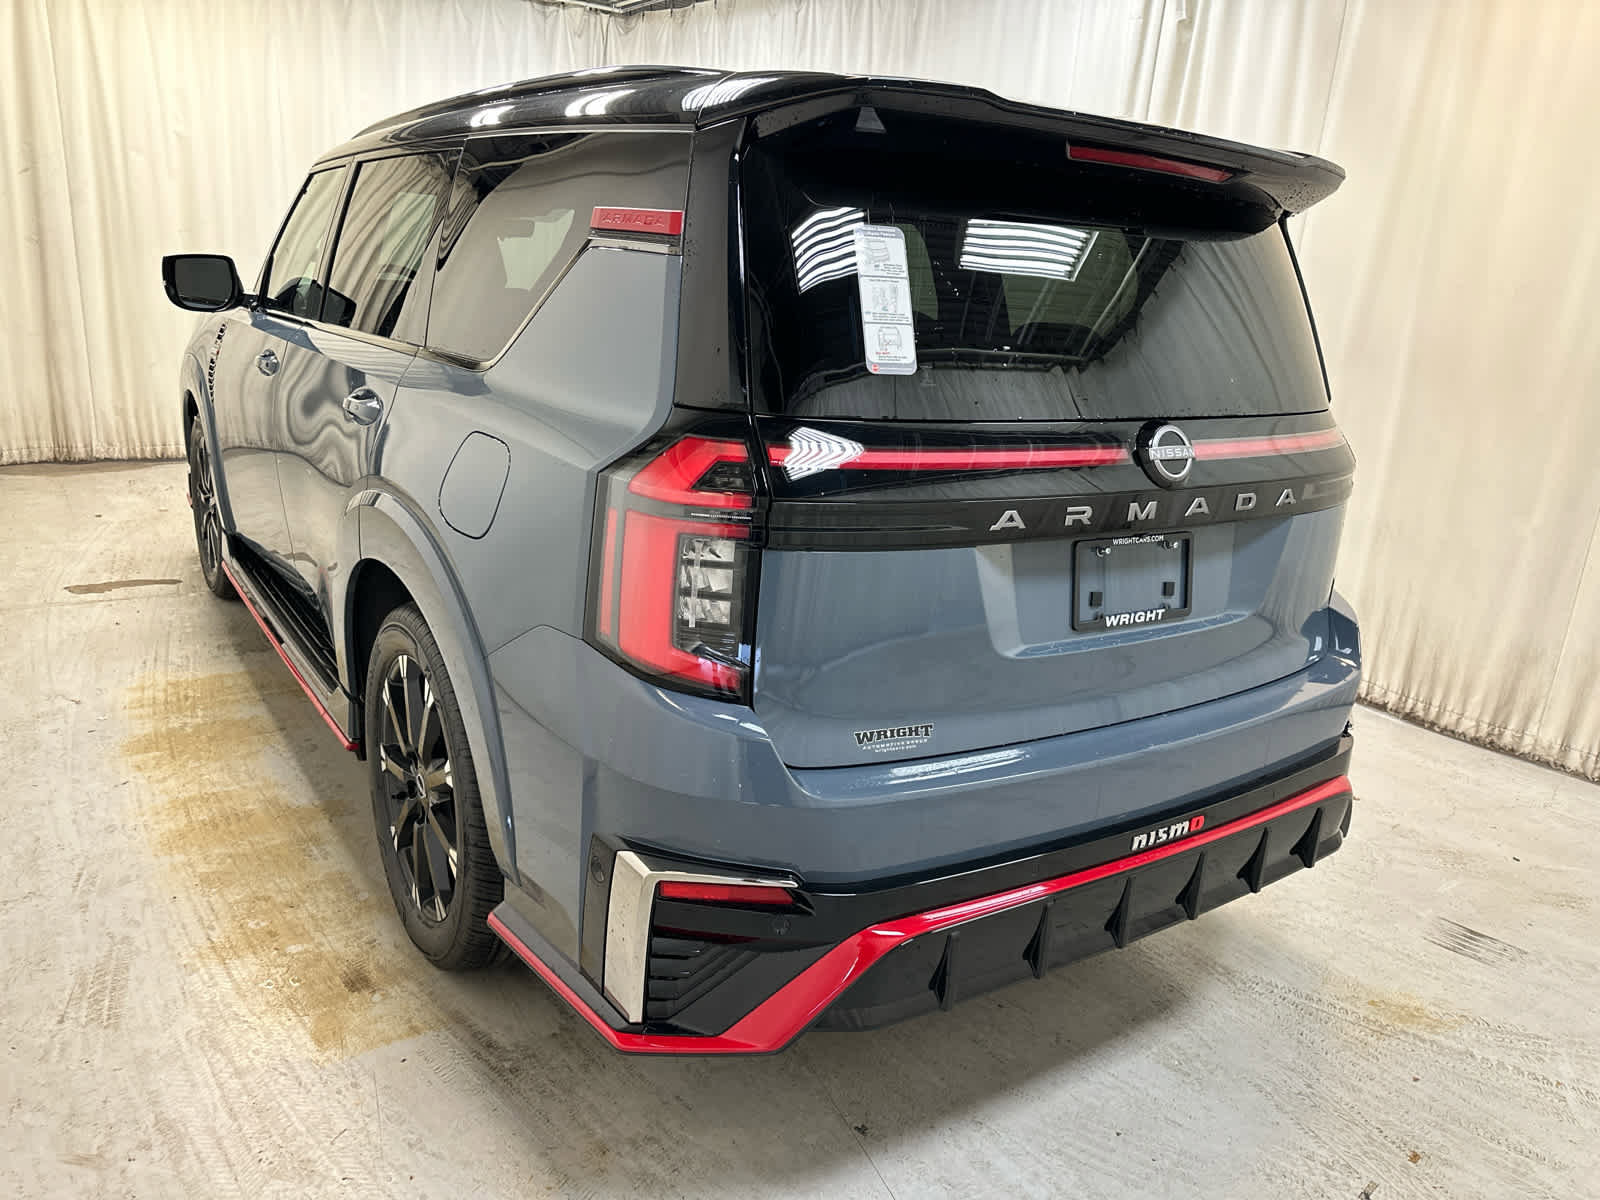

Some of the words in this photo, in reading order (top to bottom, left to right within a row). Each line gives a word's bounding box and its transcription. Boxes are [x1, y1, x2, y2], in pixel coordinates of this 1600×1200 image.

[1151, 446, 1195, 459] NISSAN
[989, 487, 1297, 531] ARMADA
[1105, 608, 1166, 627] WRIGHT
[854, 722, 935, 746] WRIGHT
